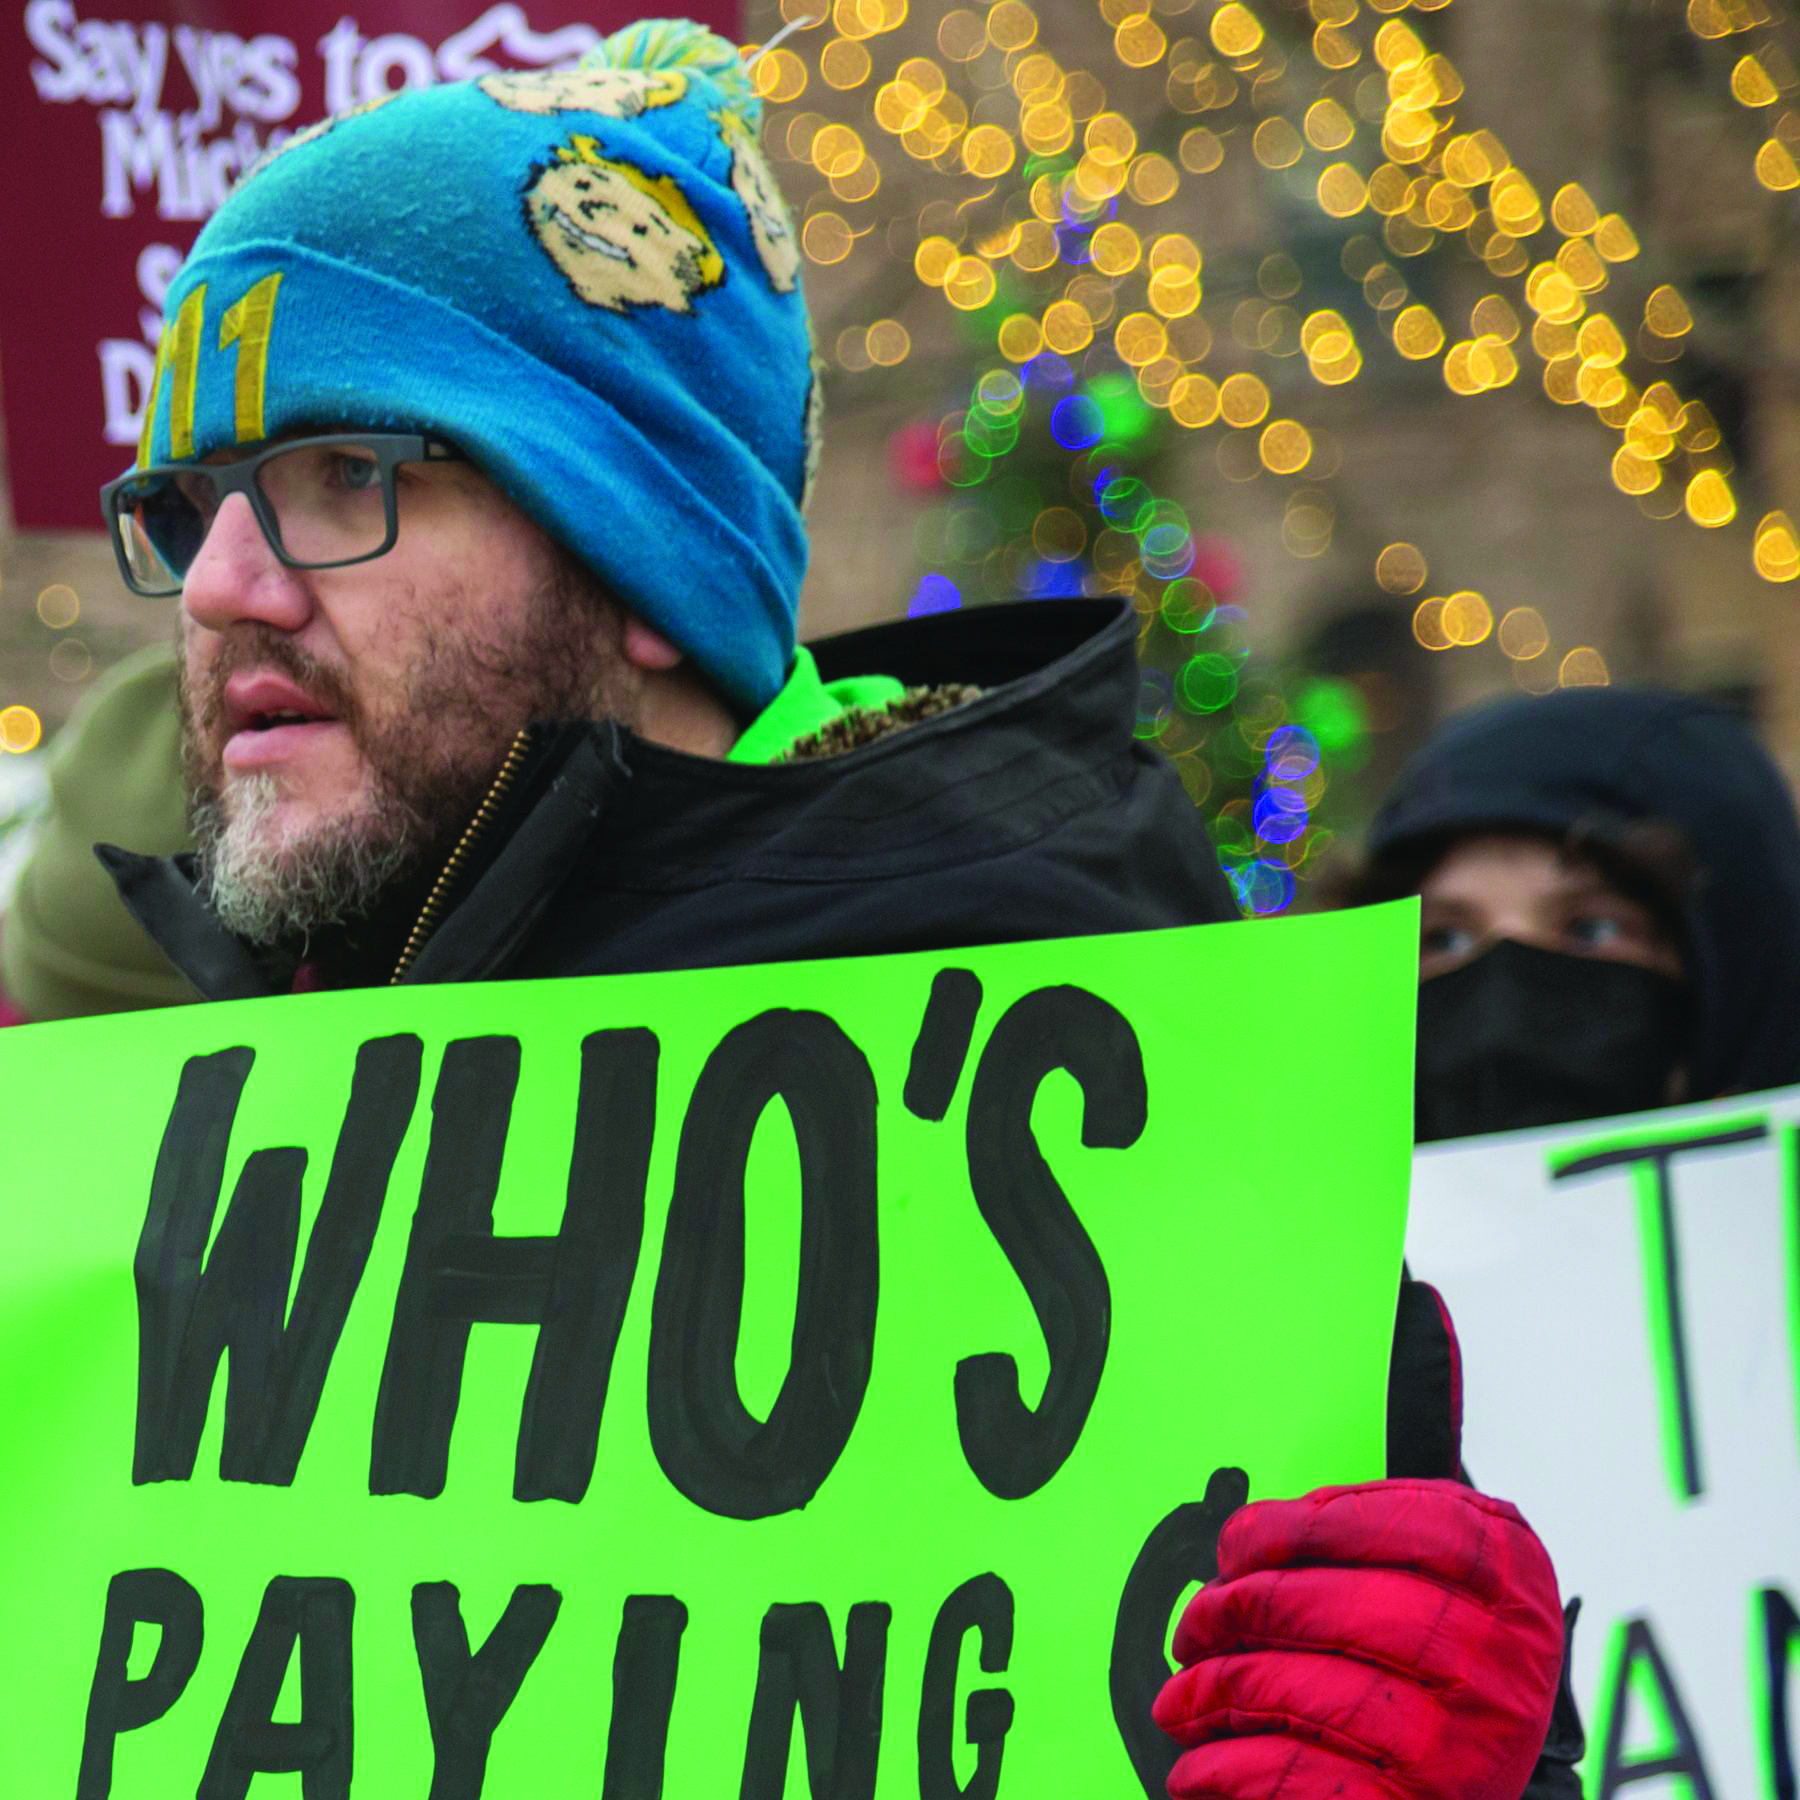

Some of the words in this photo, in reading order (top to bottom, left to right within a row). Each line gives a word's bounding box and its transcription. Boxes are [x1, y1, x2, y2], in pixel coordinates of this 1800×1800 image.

[25, 0, 168, 122] Say
[171, 24, 301, 133] yes
[316, 15, 434, 118] to
[131, 967, 1149, 1521] WHO'S
